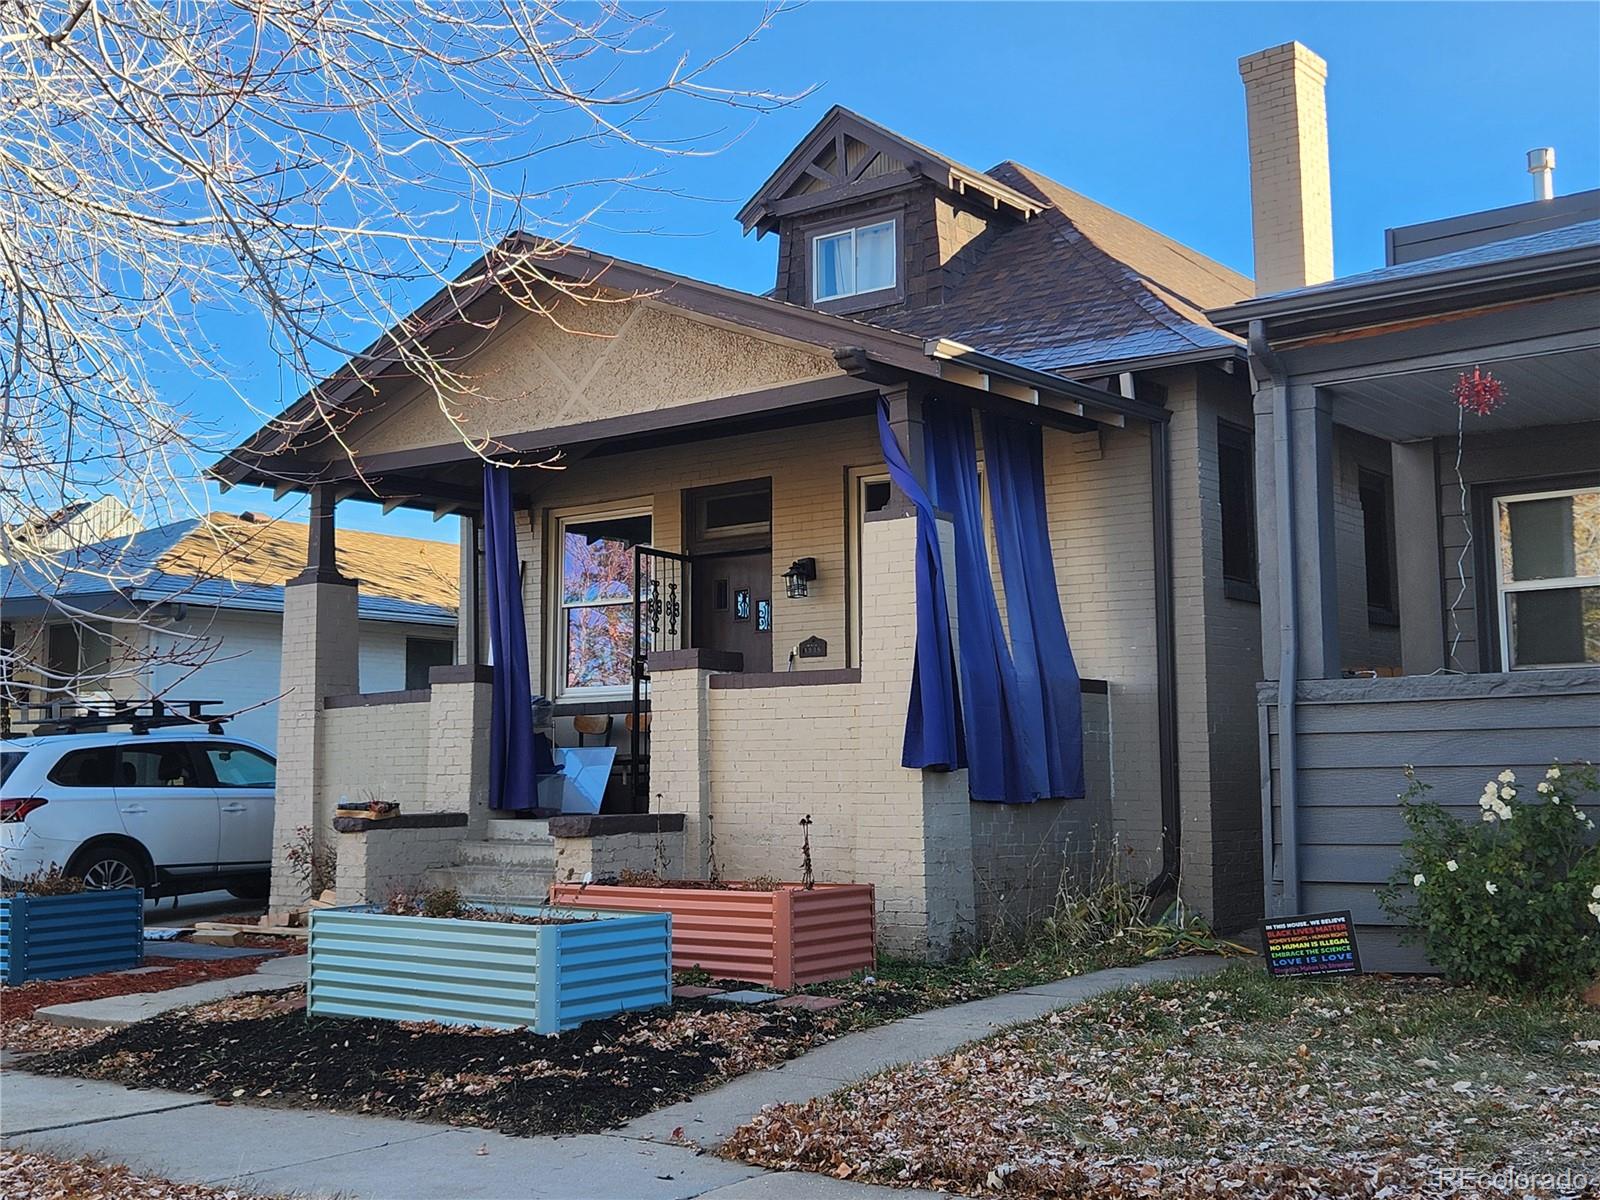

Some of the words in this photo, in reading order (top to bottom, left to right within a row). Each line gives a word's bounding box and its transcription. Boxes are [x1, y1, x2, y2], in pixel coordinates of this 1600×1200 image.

[1321, 917, 1345, 925] BELIEVE
[1267, 930, 1291, 938] BLACK
[1294, 927, 1314, 935] LIVES
[1316, 924, 1347, 933] MATTER
[1271, 950, 1304, 958] EMBRACE
[1321, 945, 1351, 954] SCIENCE
[1282, 942, 1309, 950] HUMAN
[1272, 958, 1302, 967] LOVE
[1322, 953, 1352, 962] LOVE
